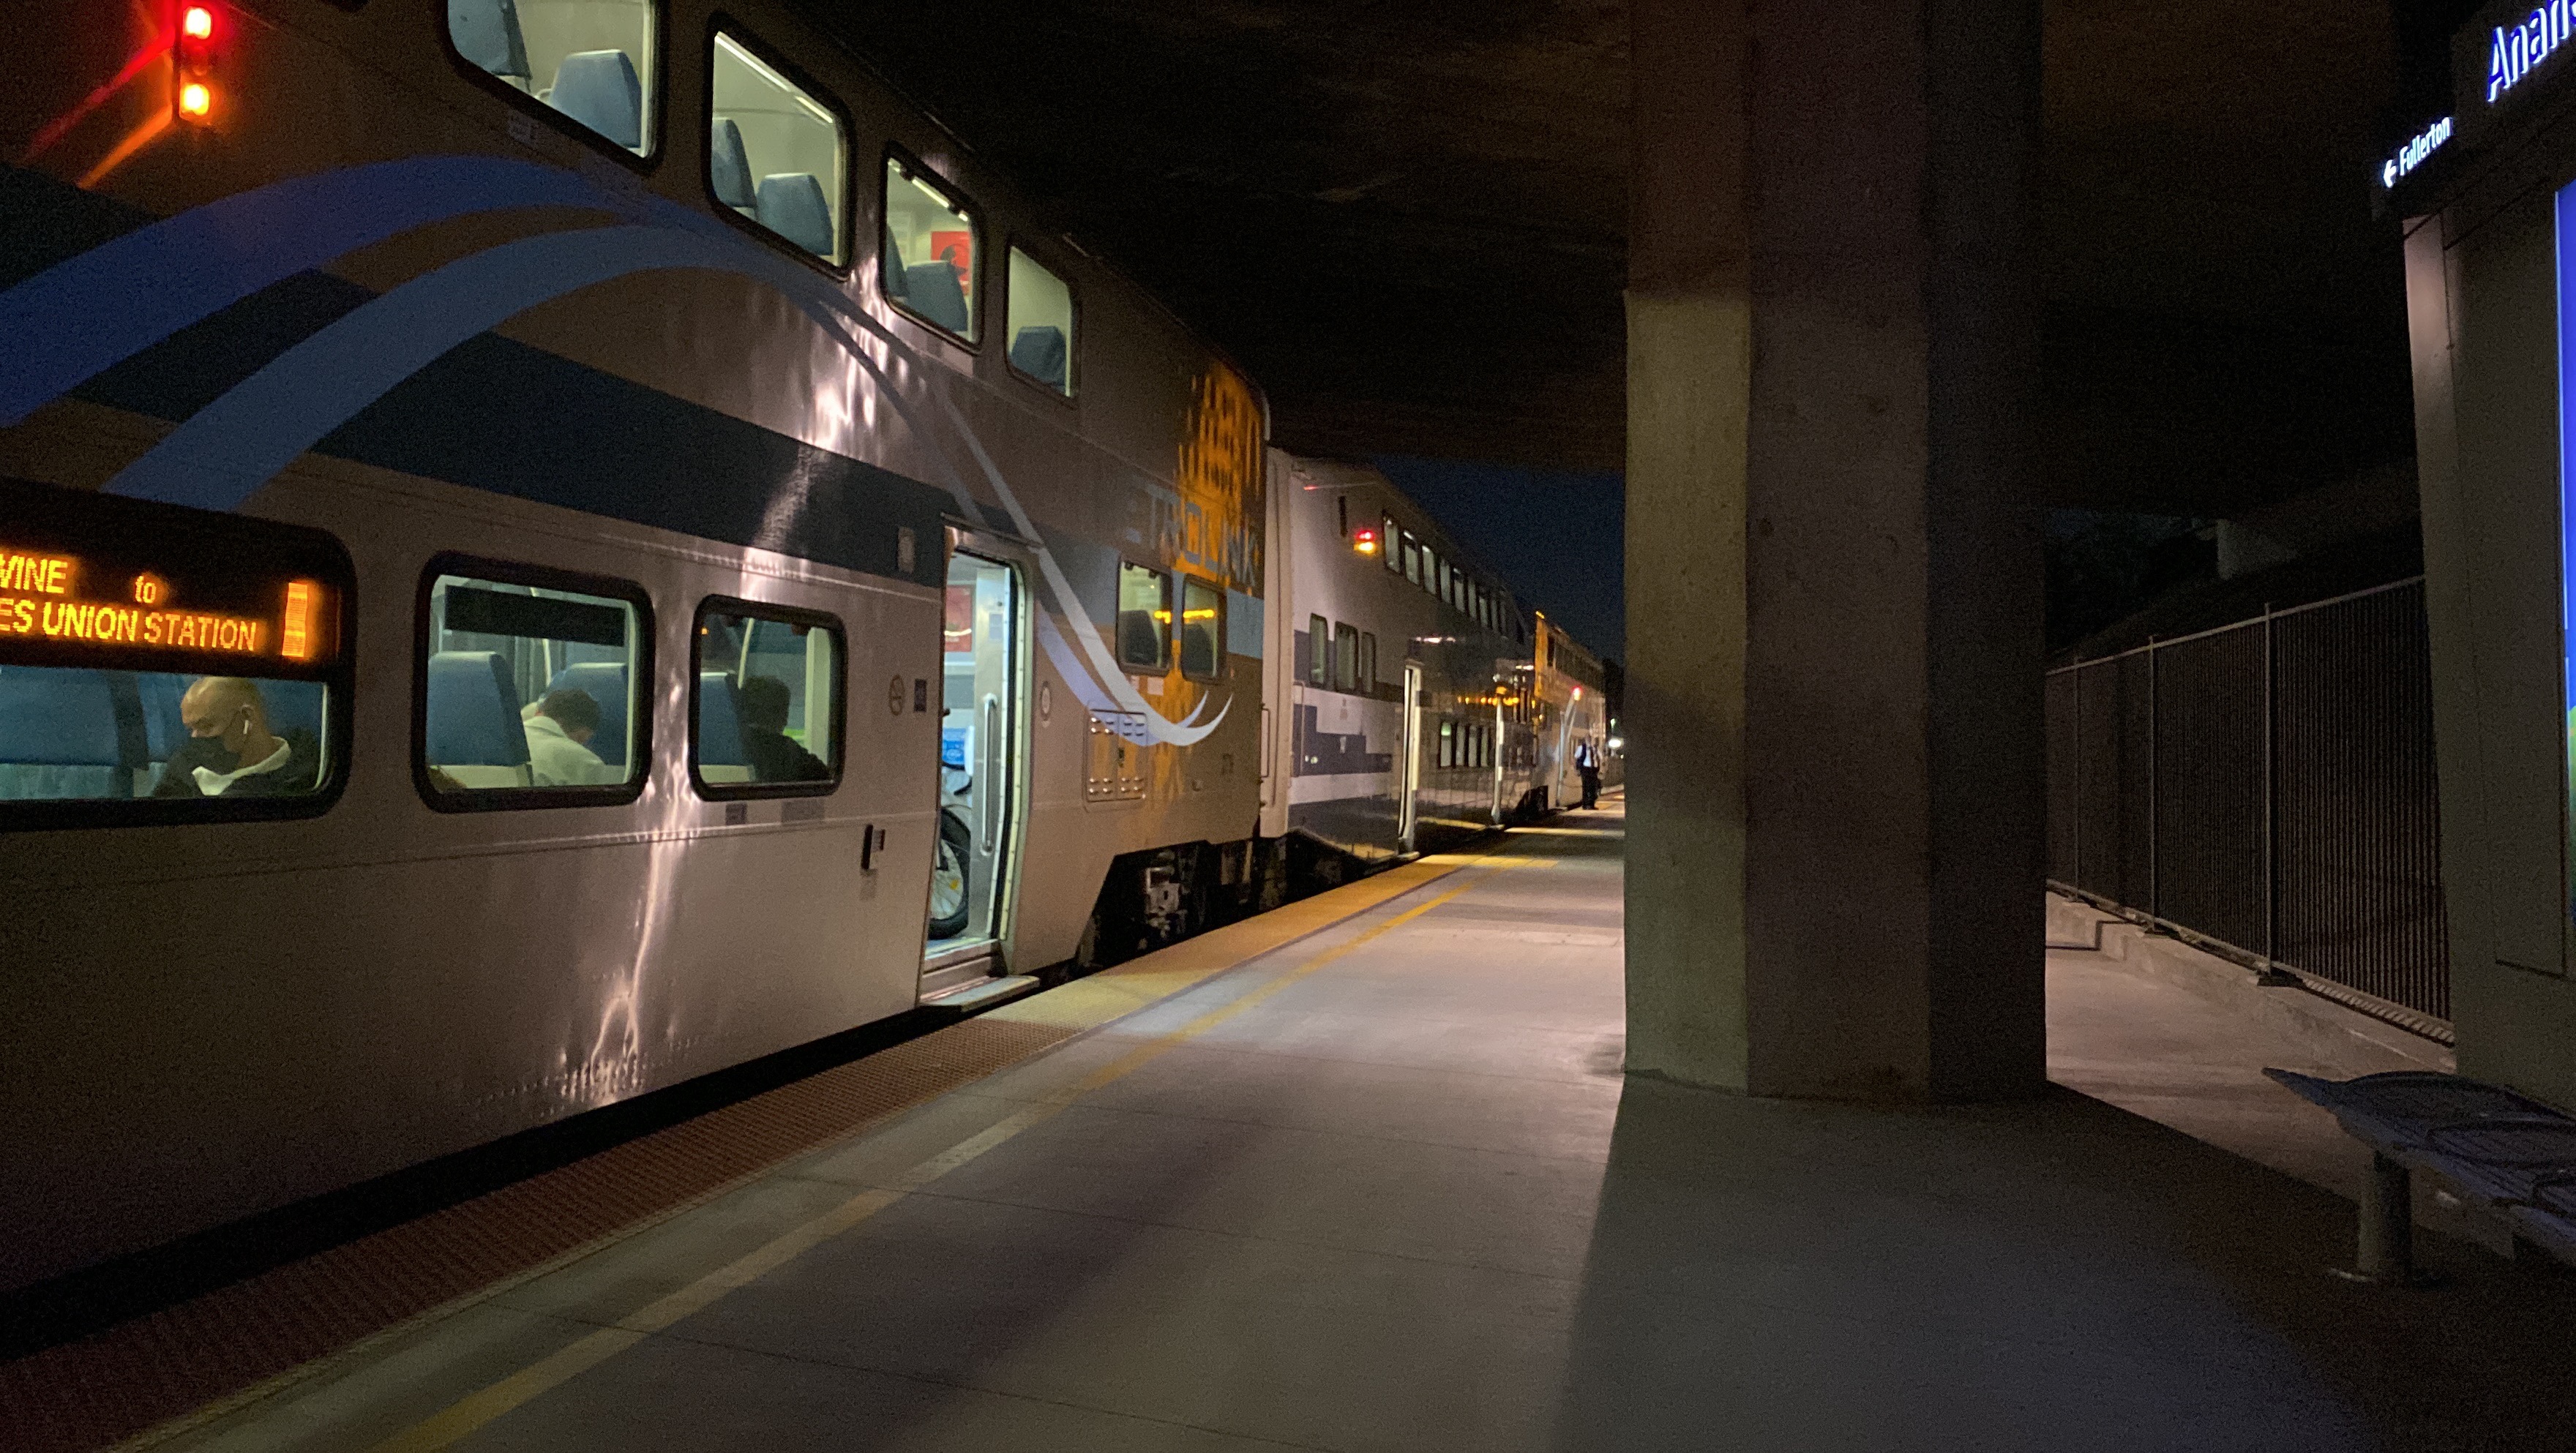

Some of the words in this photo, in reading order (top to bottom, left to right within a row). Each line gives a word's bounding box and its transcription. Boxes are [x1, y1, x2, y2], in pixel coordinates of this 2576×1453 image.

[2400, 116, 2450, 176] Fullerton
[135, 575, 157, 604] to
[42, 601, 138, 642] UNION
[143, 612, 257, 652] STATION
